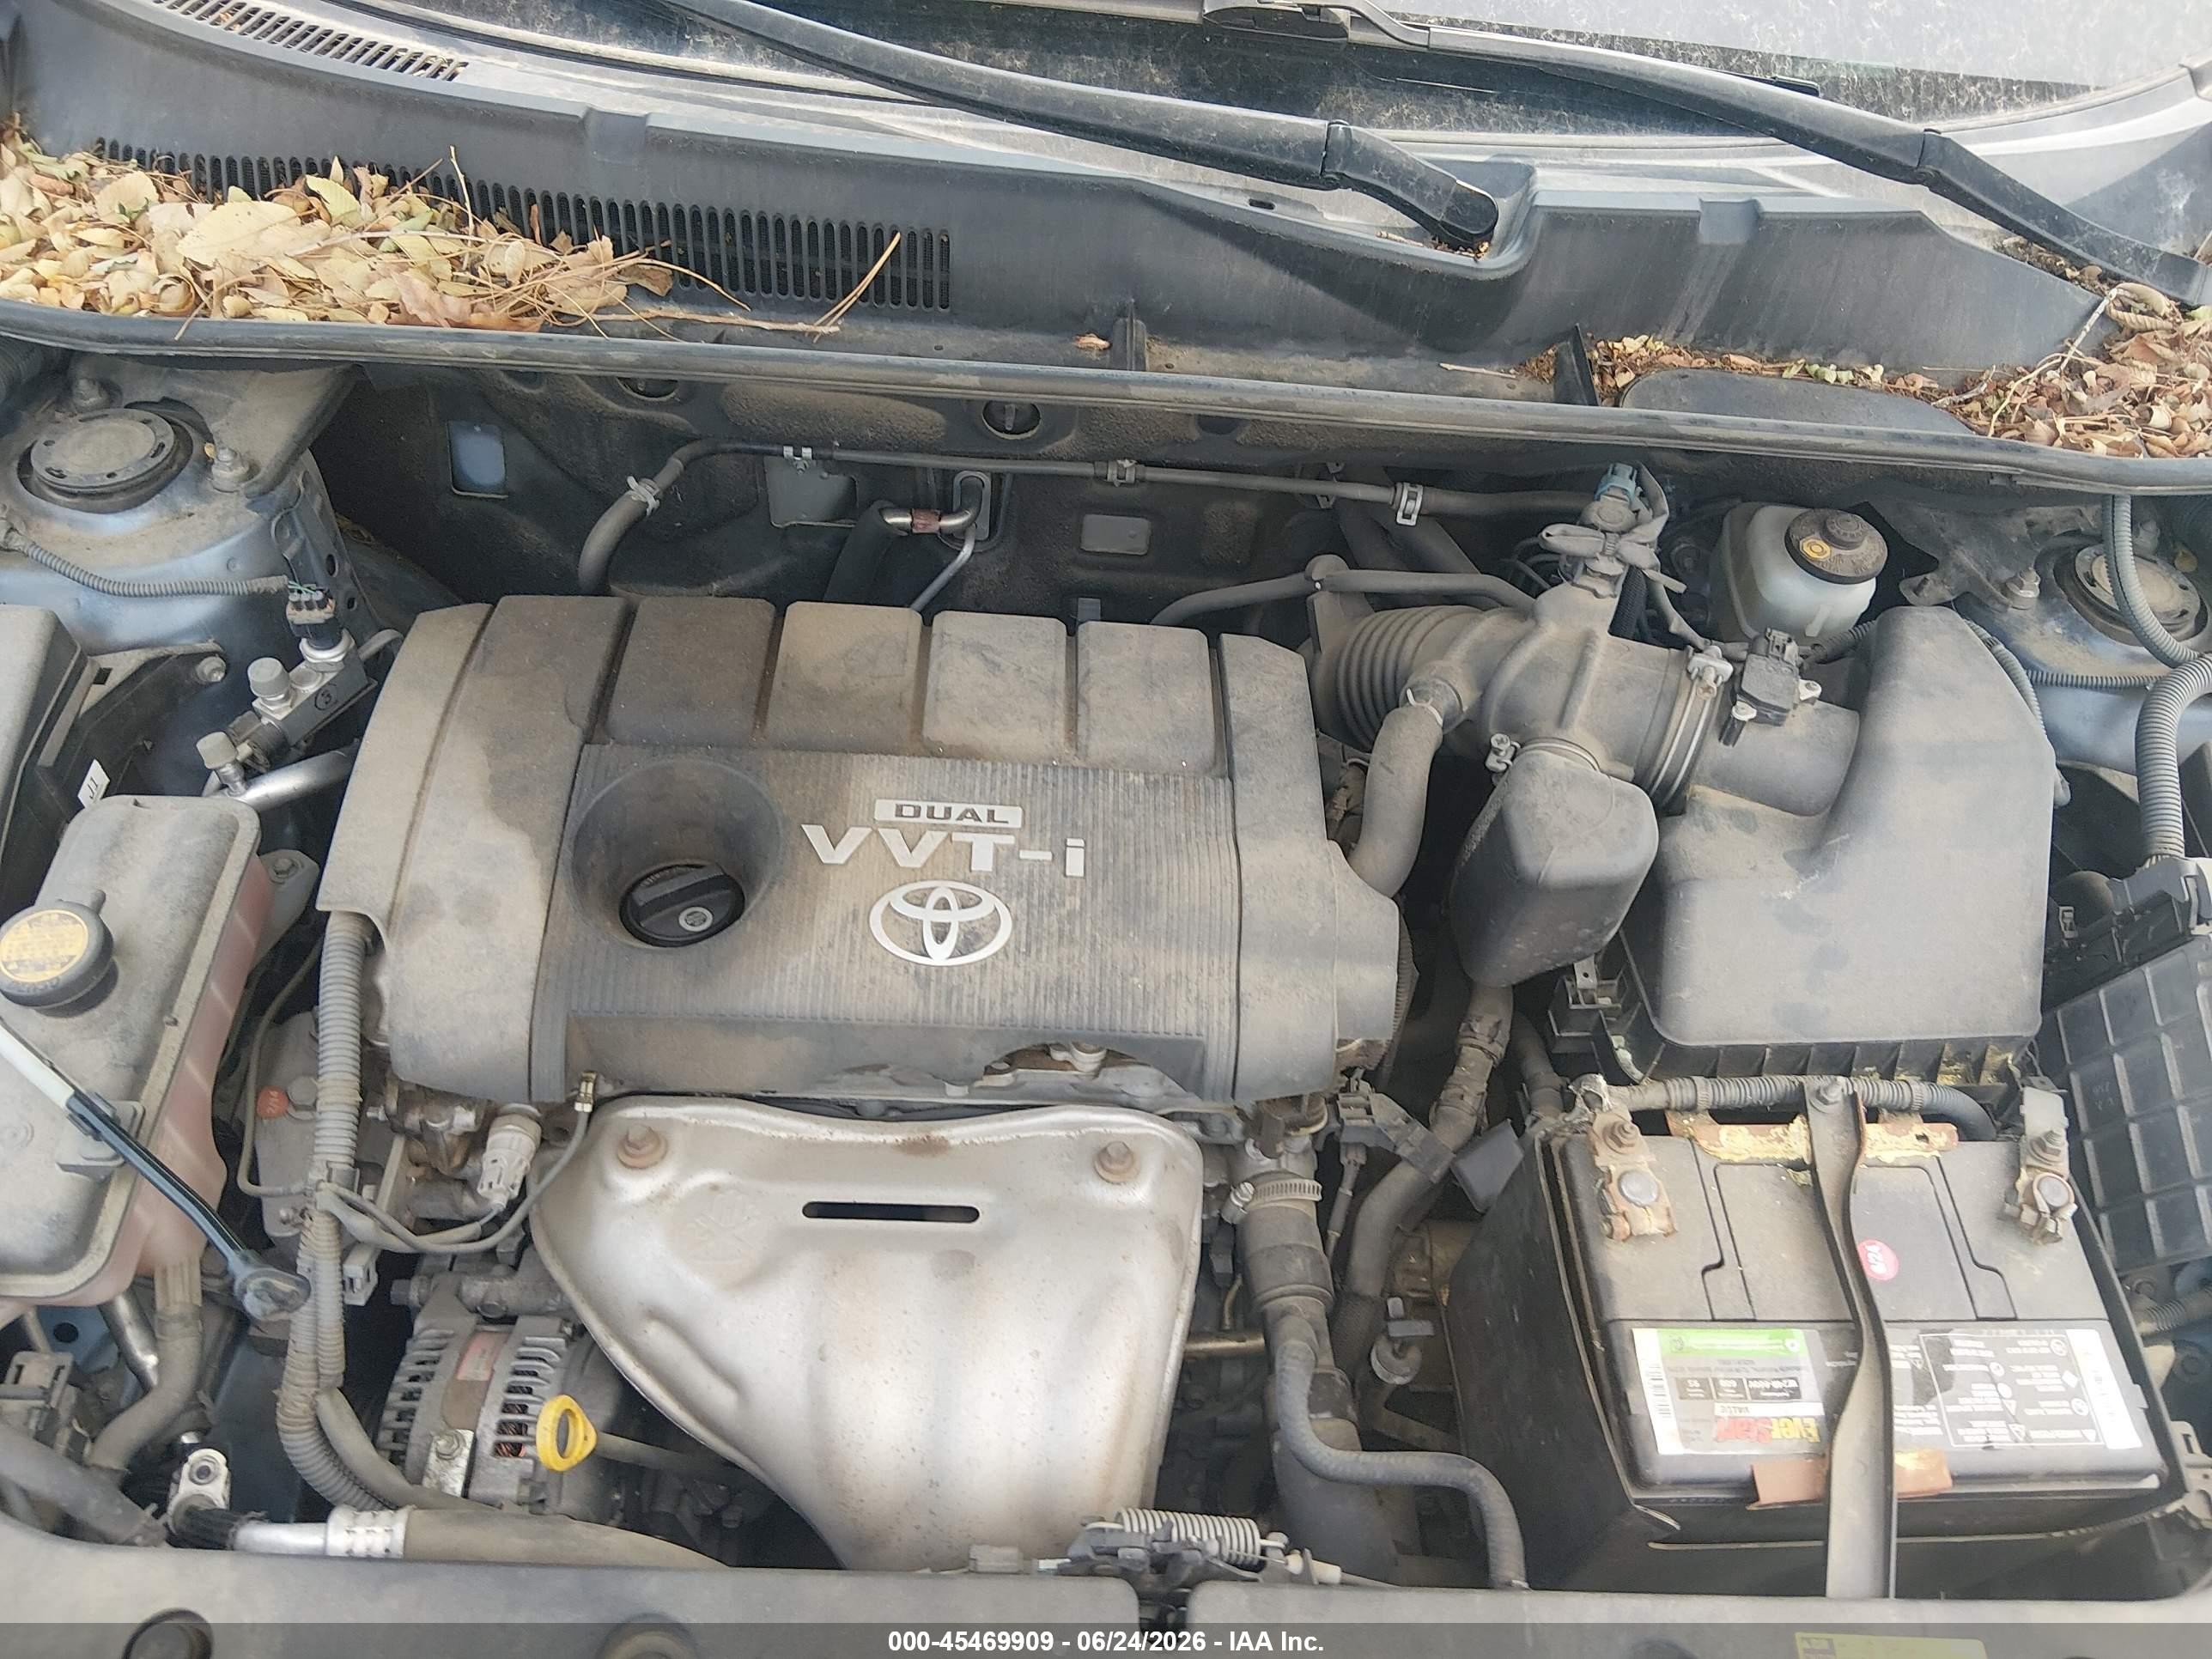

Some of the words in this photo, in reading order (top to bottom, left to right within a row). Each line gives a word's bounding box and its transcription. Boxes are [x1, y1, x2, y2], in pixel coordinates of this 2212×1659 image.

[895, 802, 1009, 825] DUAL
[800, 823, 1085, 878] VVT-i
[1716, 1417, 1820, 1444] EverStart
